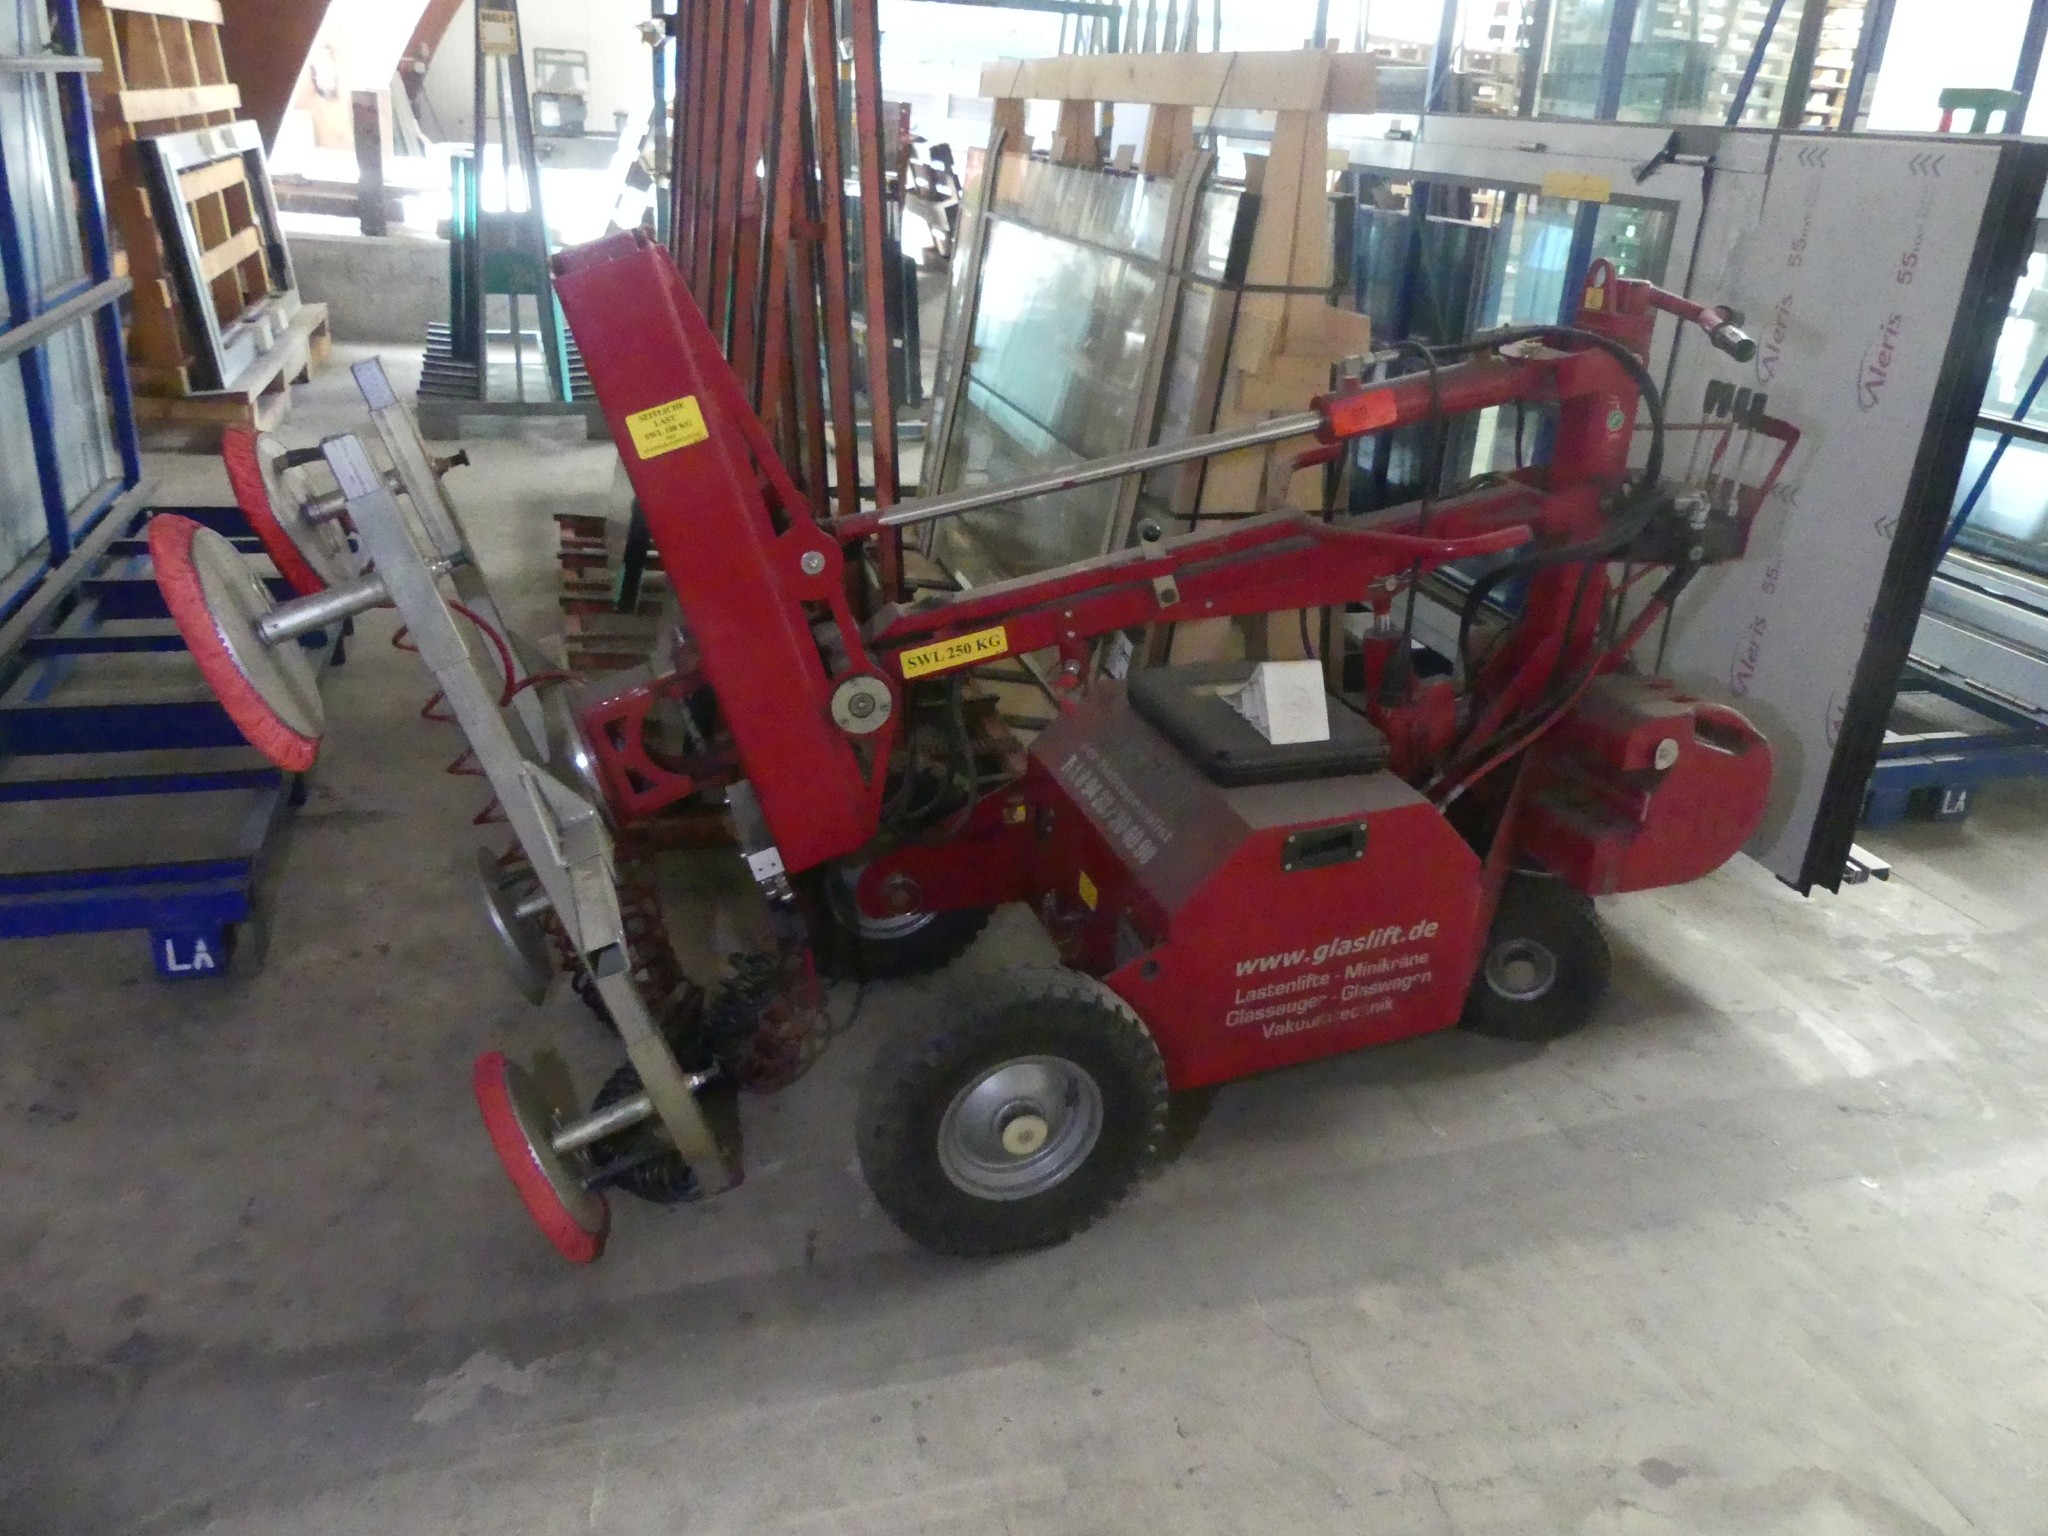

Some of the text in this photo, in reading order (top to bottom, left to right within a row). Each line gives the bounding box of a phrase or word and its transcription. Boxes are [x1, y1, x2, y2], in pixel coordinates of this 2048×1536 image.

[1755, 294, 1795, 387] Aleris
[1858, 252, 1918, 413] Aleris 55
[907, 635, 1001, 669] SWL 250 KG
[1942, 790, 1967, 814] LA
[165, 938, 215, 971] LA
[1236, 919, 1439, 977] www.glaslift.de
[1235, 972, 1331, 1005] Lastenlifte
[1225, 995, 1328, 1027] Glassauger
[1262, 997, 1394, 1040] Vakuumecnik
